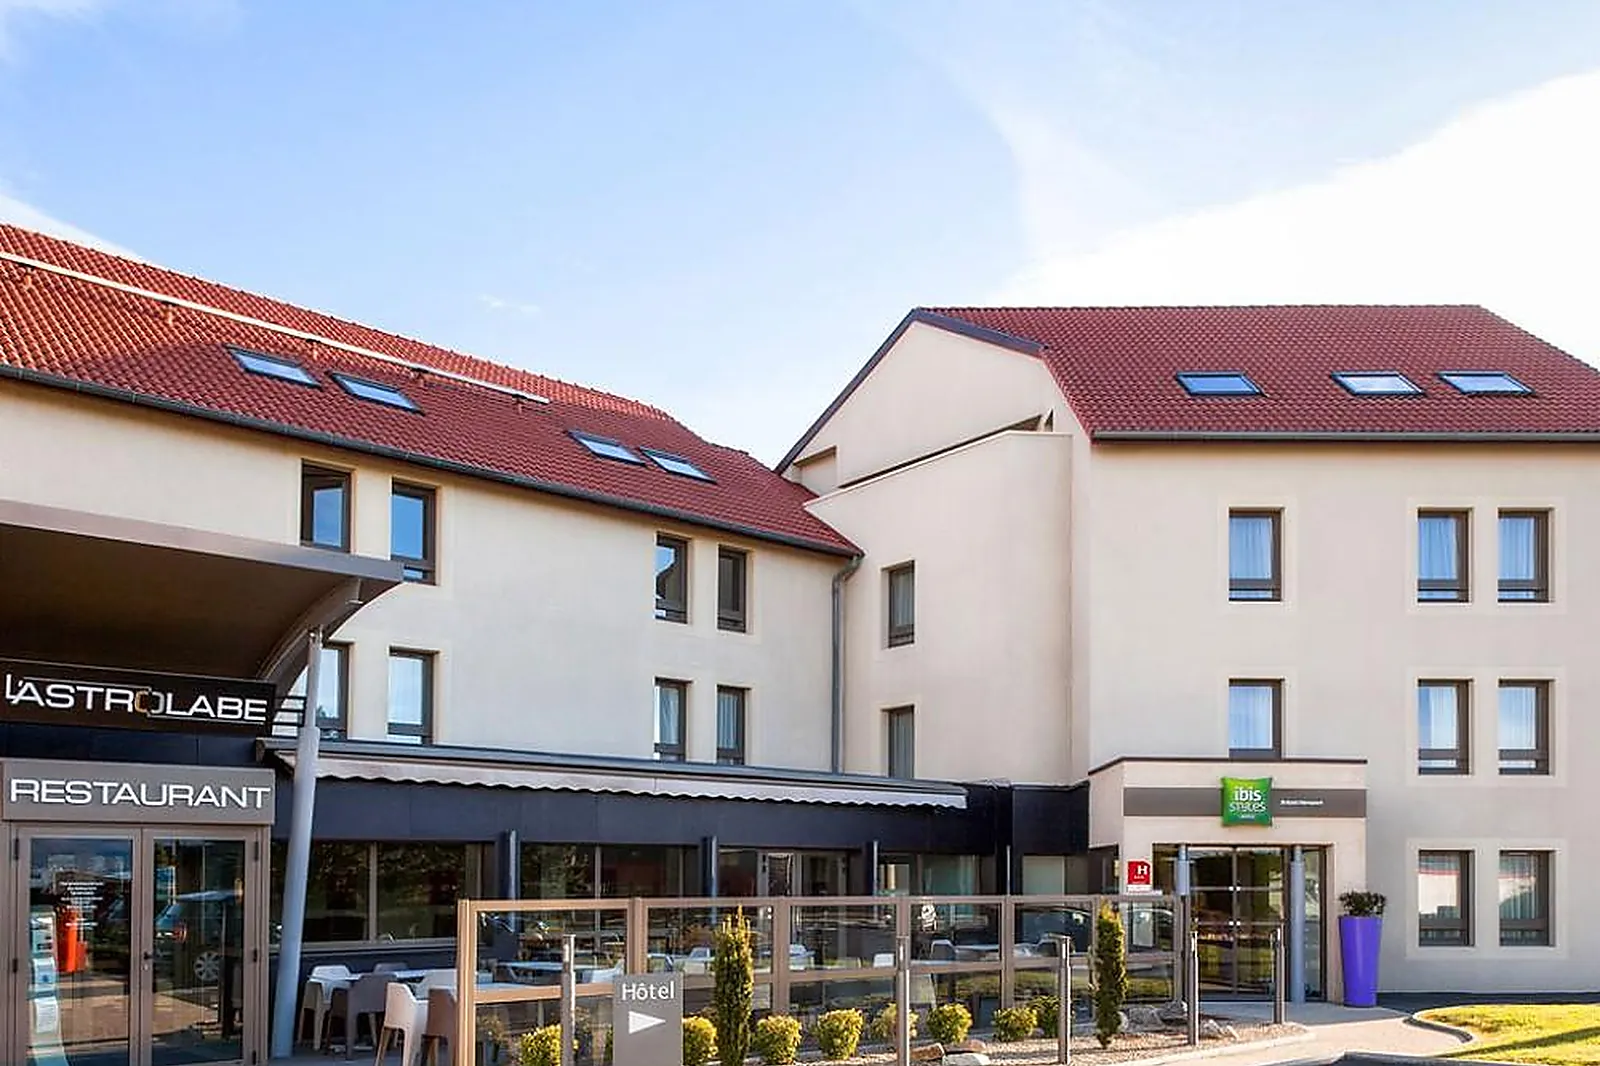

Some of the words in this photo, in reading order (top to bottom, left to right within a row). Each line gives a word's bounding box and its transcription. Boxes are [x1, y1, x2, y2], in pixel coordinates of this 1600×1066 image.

[5, 673, 268, 721] L'ASTROLABE
[10, 778, 271, 809] RESTAURANT
[1234, 786, 1262, 802] ibis
[1137, 865, 1148, 875] H
[621, 980, 675, 1001] Hôtel
